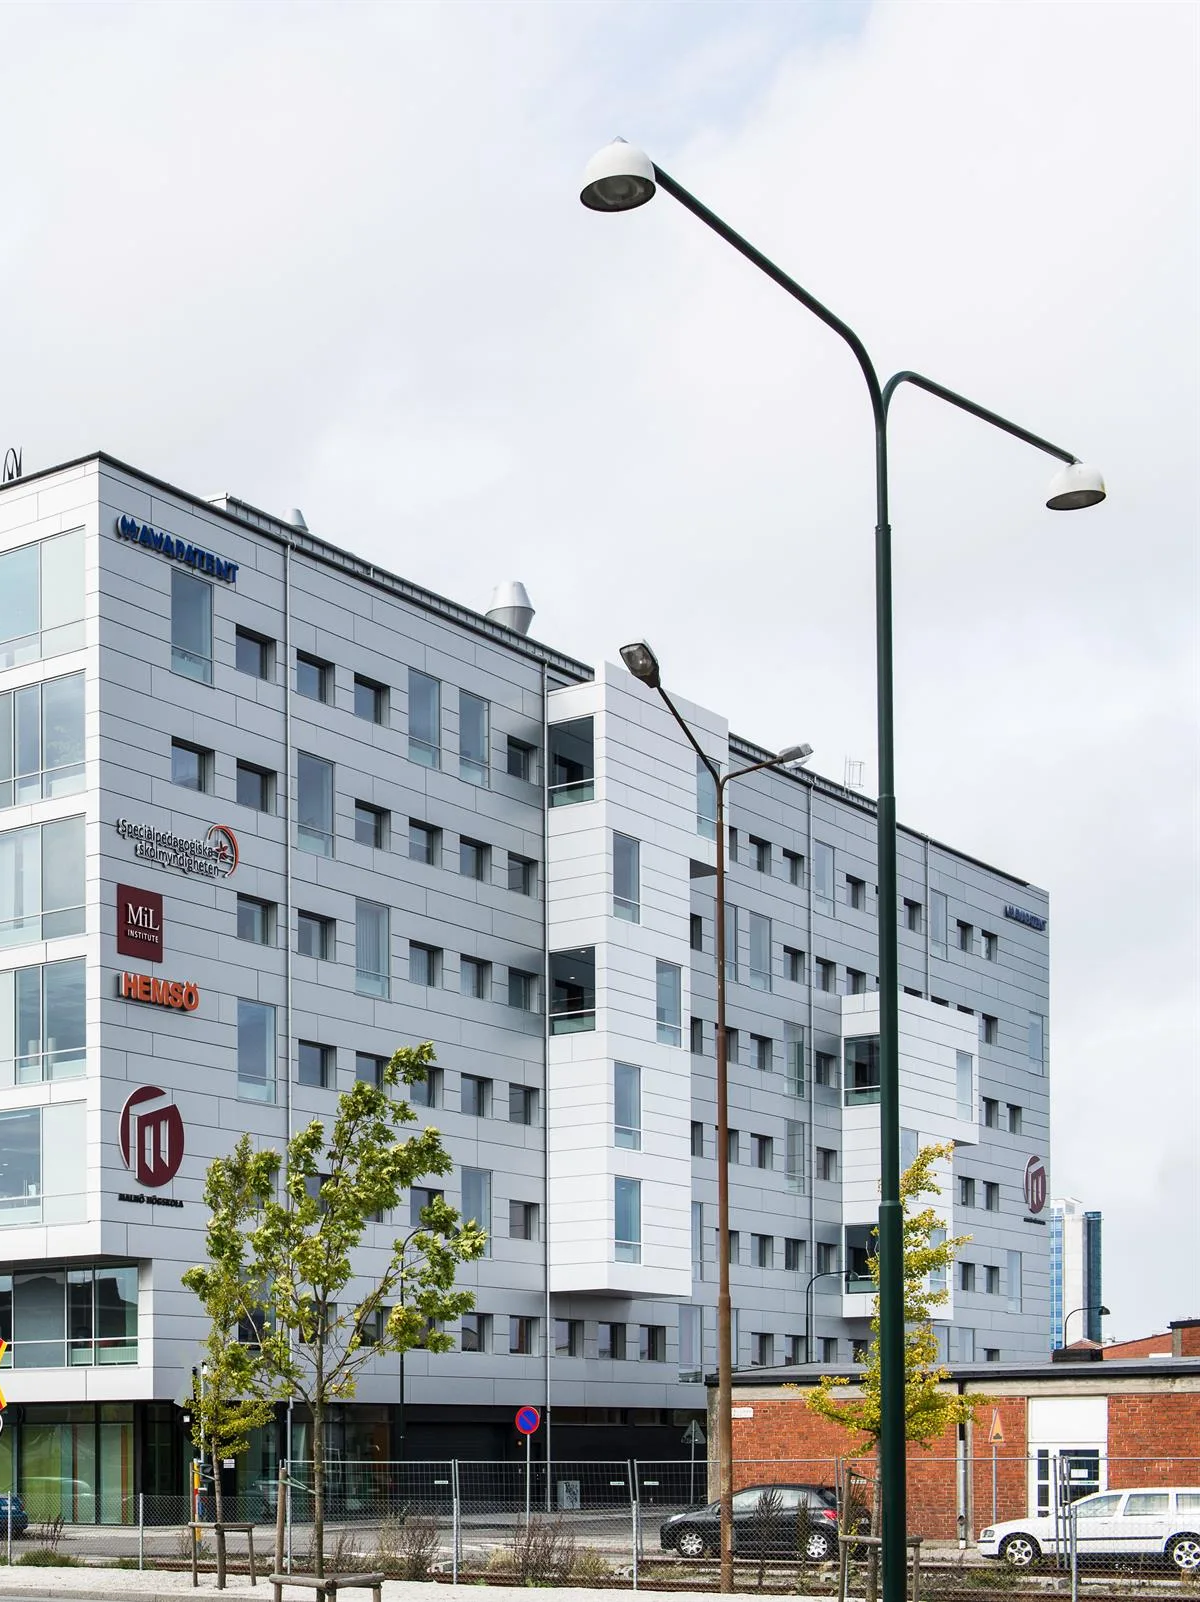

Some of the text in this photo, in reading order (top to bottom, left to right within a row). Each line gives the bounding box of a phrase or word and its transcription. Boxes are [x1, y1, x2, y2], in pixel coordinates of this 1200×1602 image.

[138, 523, 239, 584] AWAPATENT
[120, 818, 214, 859] Specialpedagogiska
[138, 842, 220, 876] skolmyndigheten
[127, 903, 160, 931] MiL
[127, 929, 160, 944] INSTITUTE
[122, 971, 200, 1012] HEMSÖ
